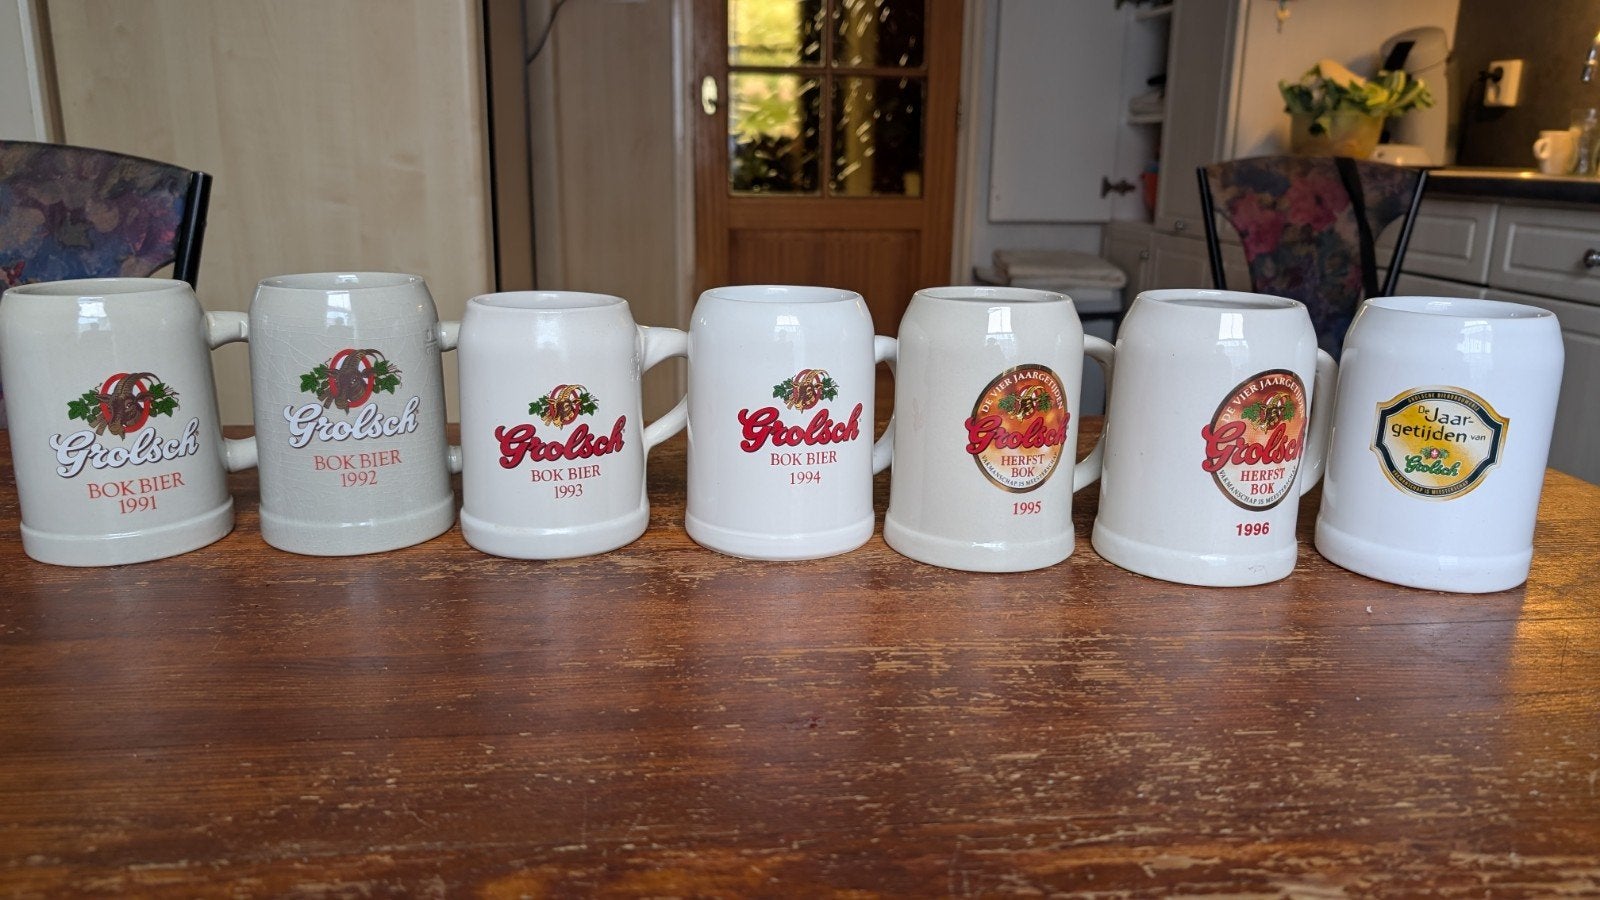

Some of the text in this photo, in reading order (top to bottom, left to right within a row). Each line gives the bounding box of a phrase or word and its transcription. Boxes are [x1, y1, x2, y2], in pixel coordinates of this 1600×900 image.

[982, 371, 1064, 413] DE VIER JAARGETIJDEN
[1222, 406, 1235, 423] DE
[1233, 384, 1259, 405] VIER
[283, 396, 420, 449] Grolsch
[1418, 405, 1474, 426] De Jaar-
[738, 403, 863, 453] Grolsch
[965, 412, 1070, 455] Grolsch
[1391, 423, 1467, 442] getijden
[49, 417, 199, 478] Grolsch
[495, 415, 626, 469] Grolsch
[1201, 416, 1307, 472] Grolsch
[313, 449, 402, 471] BOK BIER
[770, 451, 837, 466] BOK BIER
[1001, 454, 1045, 466] HERFST
[1404, 454, 1461, 476] Grolsch
[341, 470, 377, 487] 1992
[531, 464, 601, 482] BOK BIER
[790, 471, 821, 485] 1994
[981, 455, 1018, 487] VAKMANSCHAP
[1011, 466, 1035, 478] BOK
[1240, 468, 1285, 481] HERFST
[87, 472, 185, 499] BOK BIER
[554, 484, 583, 499] 1993
[1219, 469, 1257, 504] VAKMANSCHAP
[1250, 482, 1275, 495] BOK
[119, 496, 157, 514] 1991
[1013, 501, 1042, 515] 1995
[1236, 522, 1270, 536] 1996
